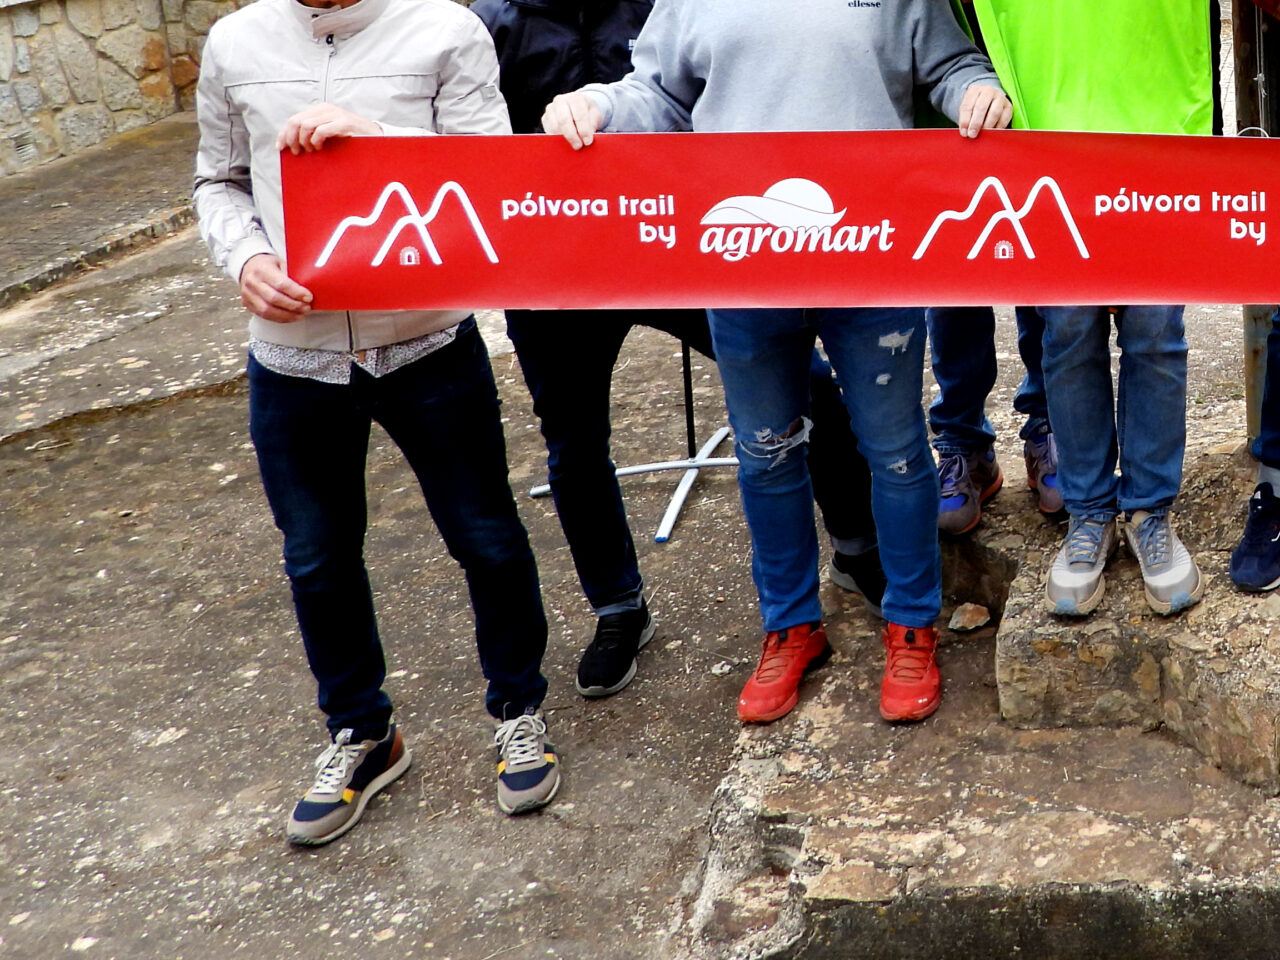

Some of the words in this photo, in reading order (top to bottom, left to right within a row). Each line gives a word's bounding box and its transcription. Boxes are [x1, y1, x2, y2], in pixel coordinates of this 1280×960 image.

[848, 0, 881, 8] ellesse
[502, 192, 609, 221] pólvora
[618, 194, 675, 216] trail
[1095, 188, 1201, 216] pólvora
[1211, 190, 1266, 213] trail
[639, 222, 676, 249] by
[699, 219, 895, 262] agromart
[1230, 218, 1267, 246] by
